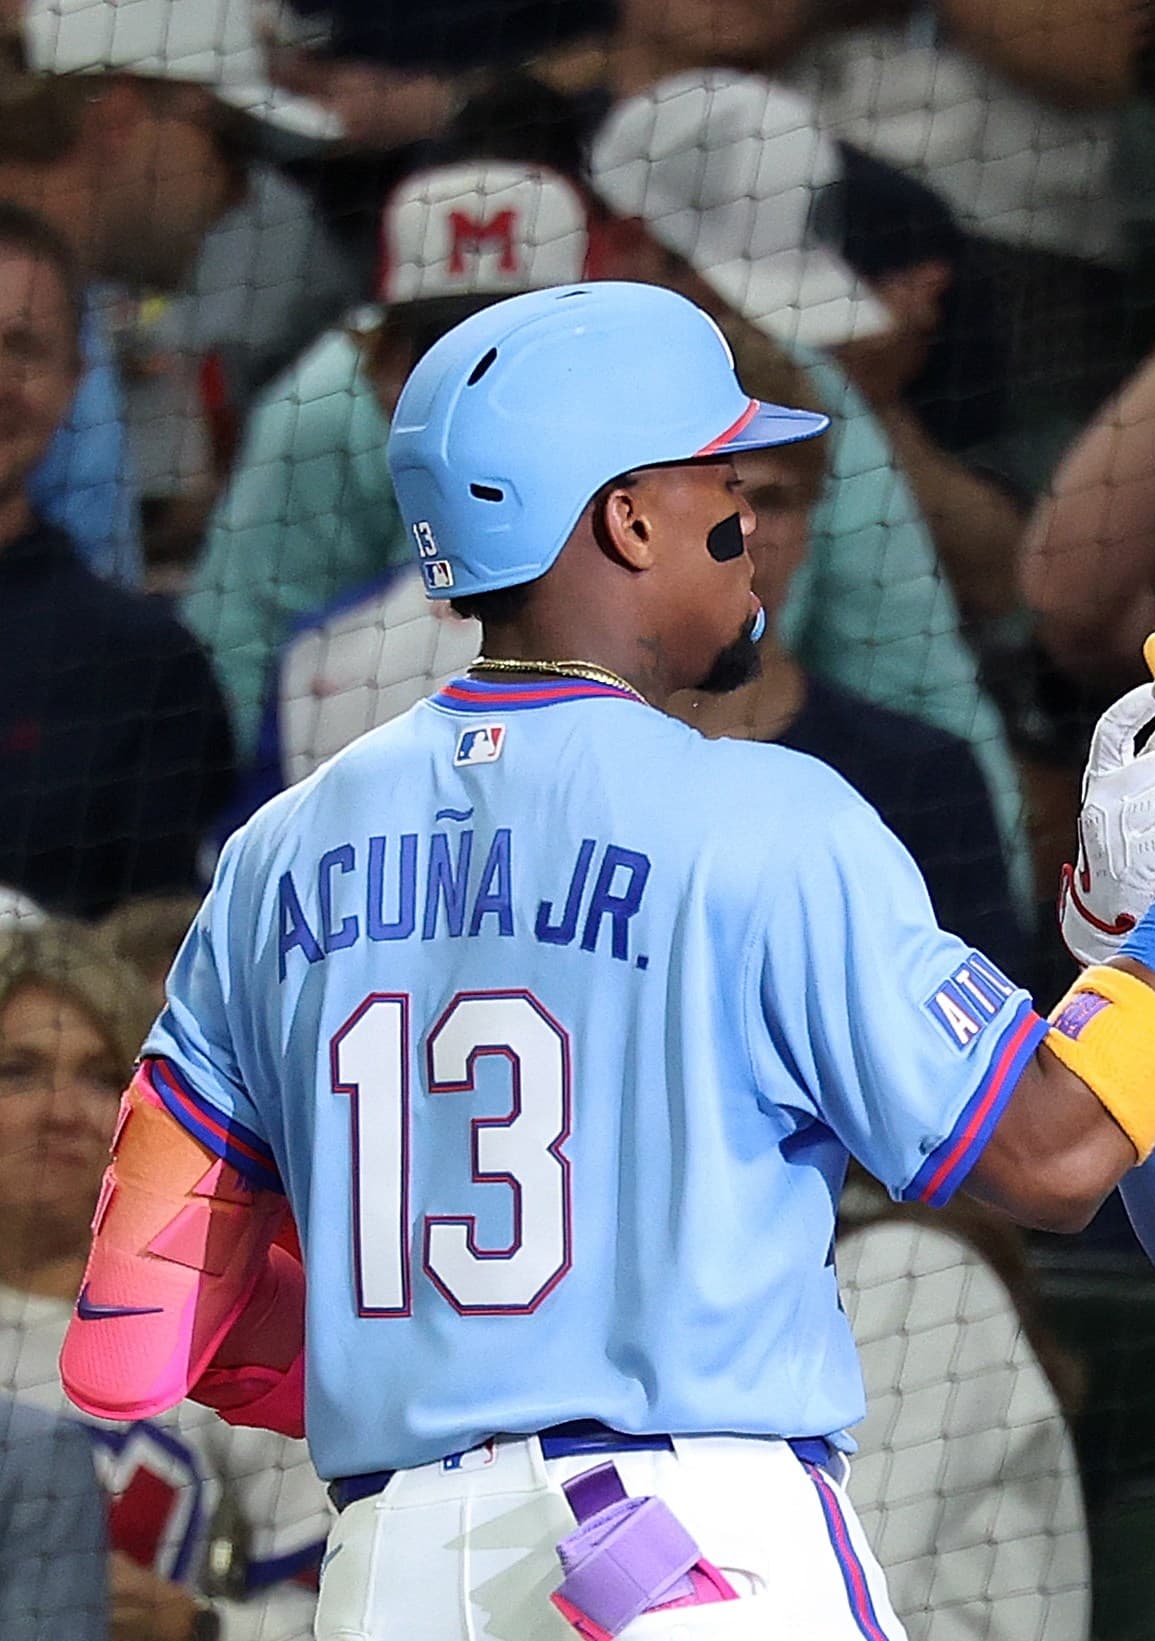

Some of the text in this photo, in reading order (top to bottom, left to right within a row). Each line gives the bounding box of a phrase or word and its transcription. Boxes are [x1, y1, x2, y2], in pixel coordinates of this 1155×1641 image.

[449, 208, 520, 274] M
[412, 521, 438, 557] 13
[279, 807, 650, 984] ACUÑA JR.
[934, 958, 1014, 1045] ATL
[331, 989, 571, 1317] 13
